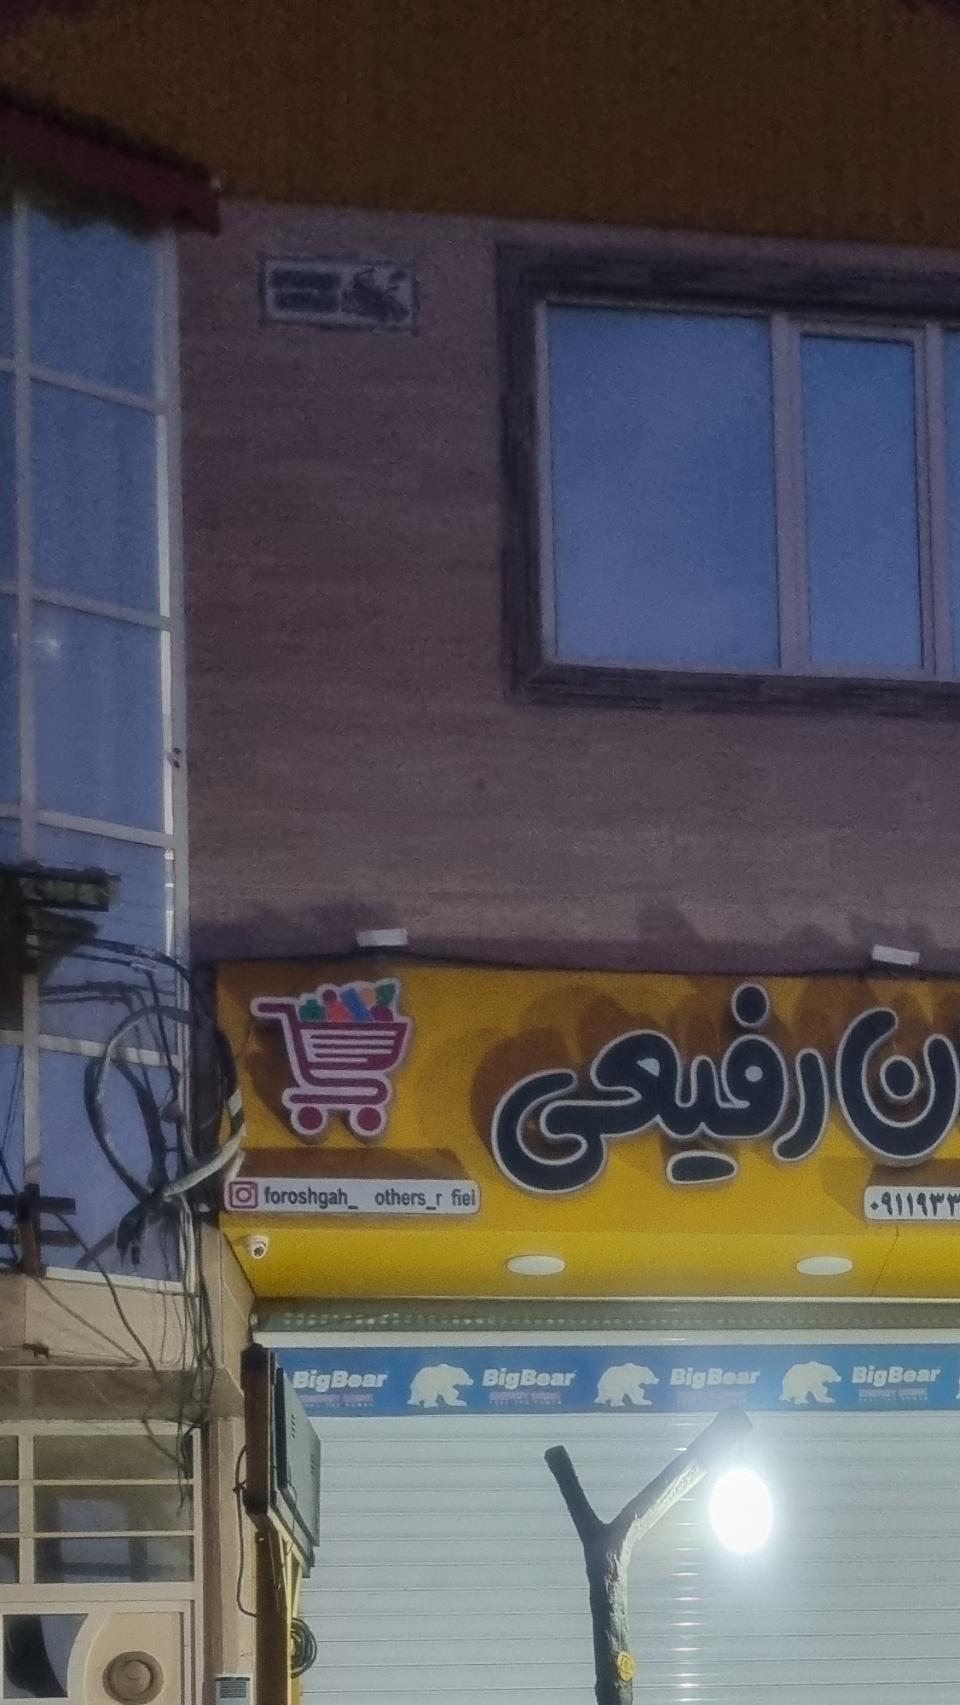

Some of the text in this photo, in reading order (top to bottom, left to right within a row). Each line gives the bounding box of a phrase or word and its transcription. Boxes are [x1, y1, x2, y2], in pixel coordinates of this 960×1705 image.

[491, 980, 830, 1194] رفیعی
[293, 1371, 386, 1394] BigBear
[482, 1369, 576, 1391] BigBear
[669, 1367, 761, 1389] BigBear
[851, 1366, 942, 1388] BigBear
